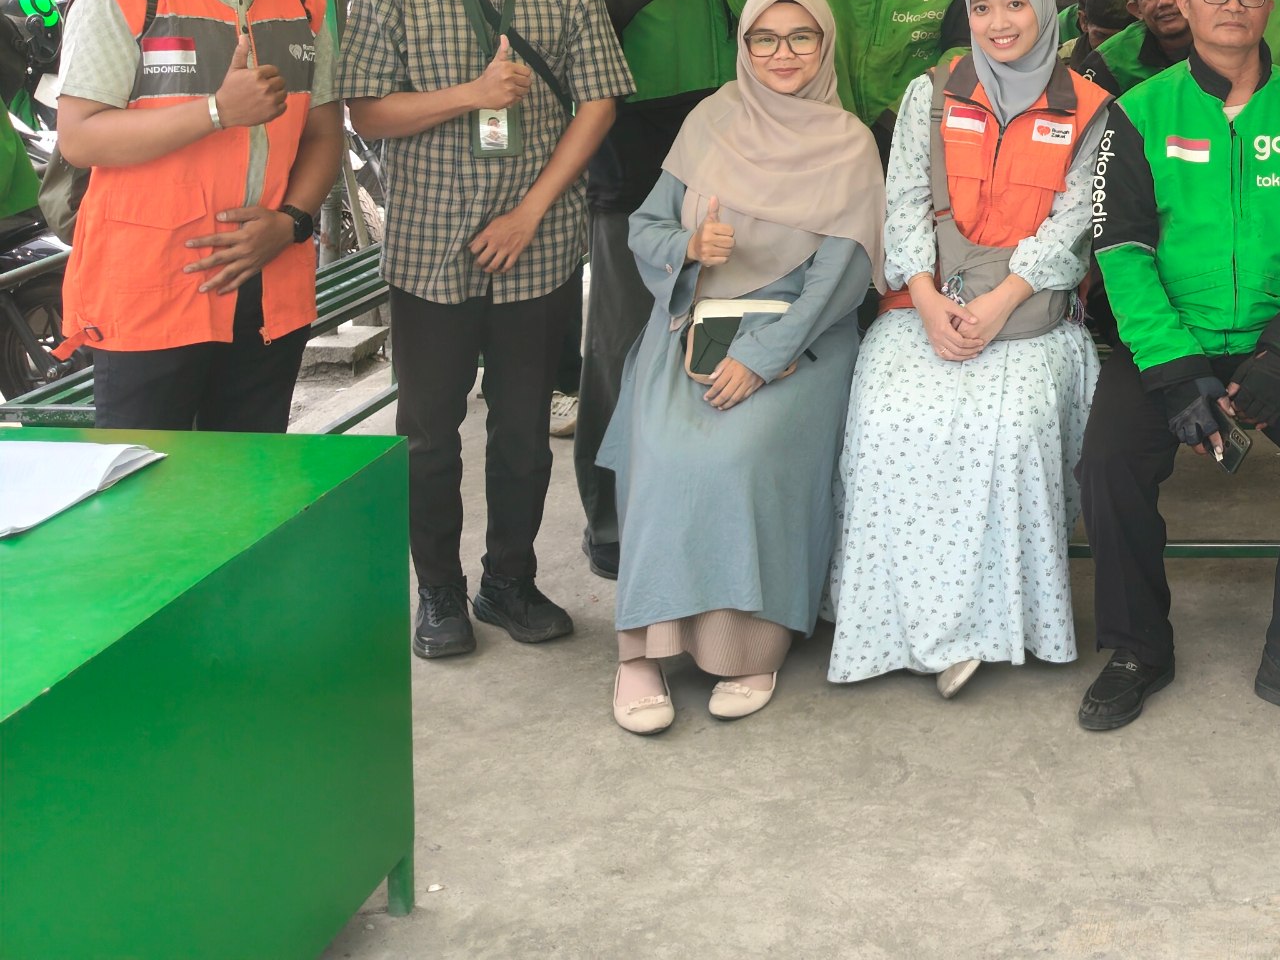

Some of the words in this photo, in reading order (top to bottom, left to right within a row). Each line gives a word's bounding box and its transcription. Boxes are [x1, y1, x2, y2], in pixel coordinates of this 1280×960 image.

[143, 64, 196, 75] INDONESIA
[1051, 127, 1070, 135] Rumah
[1093, 129, 1115, 238] tokopedia
